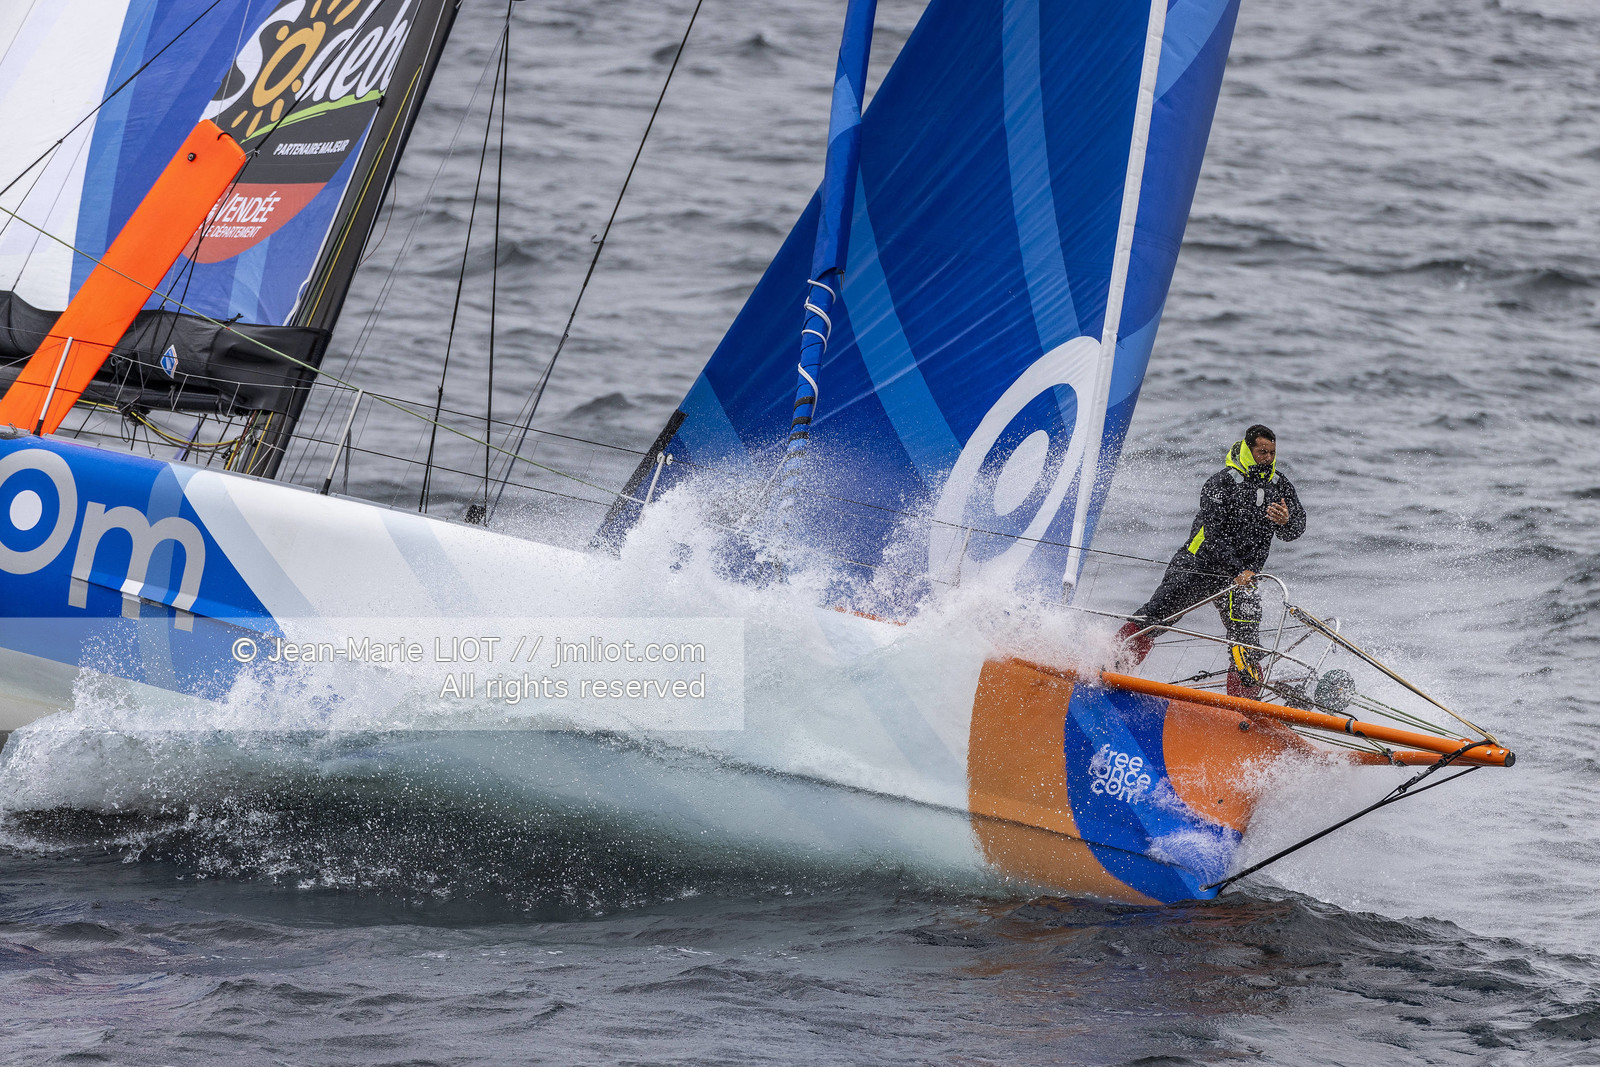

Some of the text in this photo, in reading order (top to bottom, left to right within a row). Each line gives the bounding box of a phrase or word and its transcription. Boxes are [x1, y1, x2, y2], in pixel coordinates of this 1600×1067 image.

[273, 139, 350, 156] PARTENAIRE MAJEUR
[214, 190, 281, 223] VENDÉE
[210, 223, 262, 238] DÉPARTEMENT
